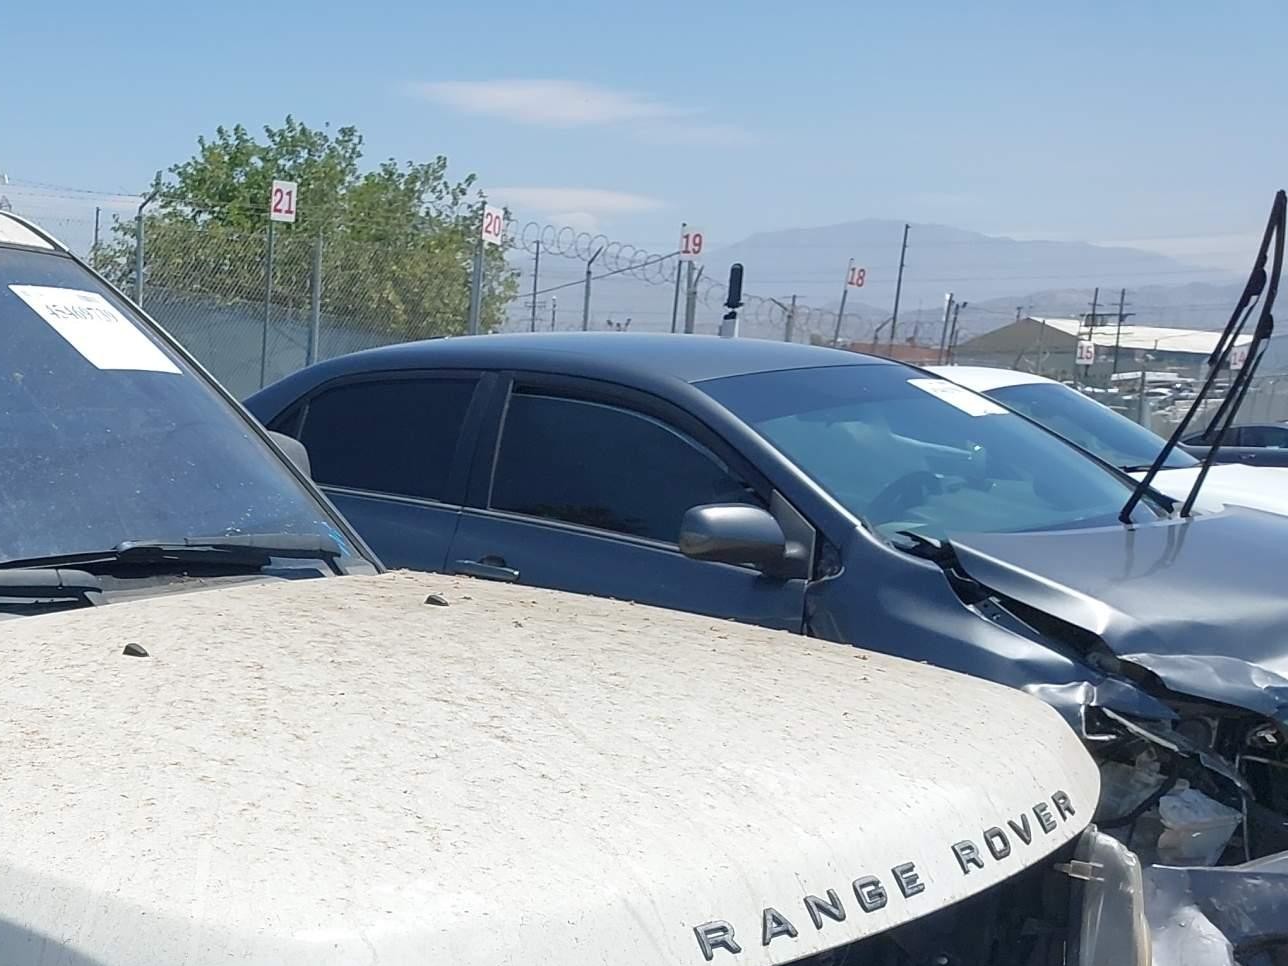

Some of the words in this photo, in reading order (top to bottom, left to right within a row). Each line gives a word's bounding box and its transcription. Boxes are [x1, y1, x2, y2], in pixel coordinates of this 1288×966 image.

[273, 187, 294, 214] 21
[485, 212, 501, 237] 20
[682, 233, 703, 254] 19
[848, 267, 866, 287] 18
[1077, 345, 1093, 360] 15
[693, 861, 925, 961] RANGE
[951, 790, 1075, 875] ROVER
